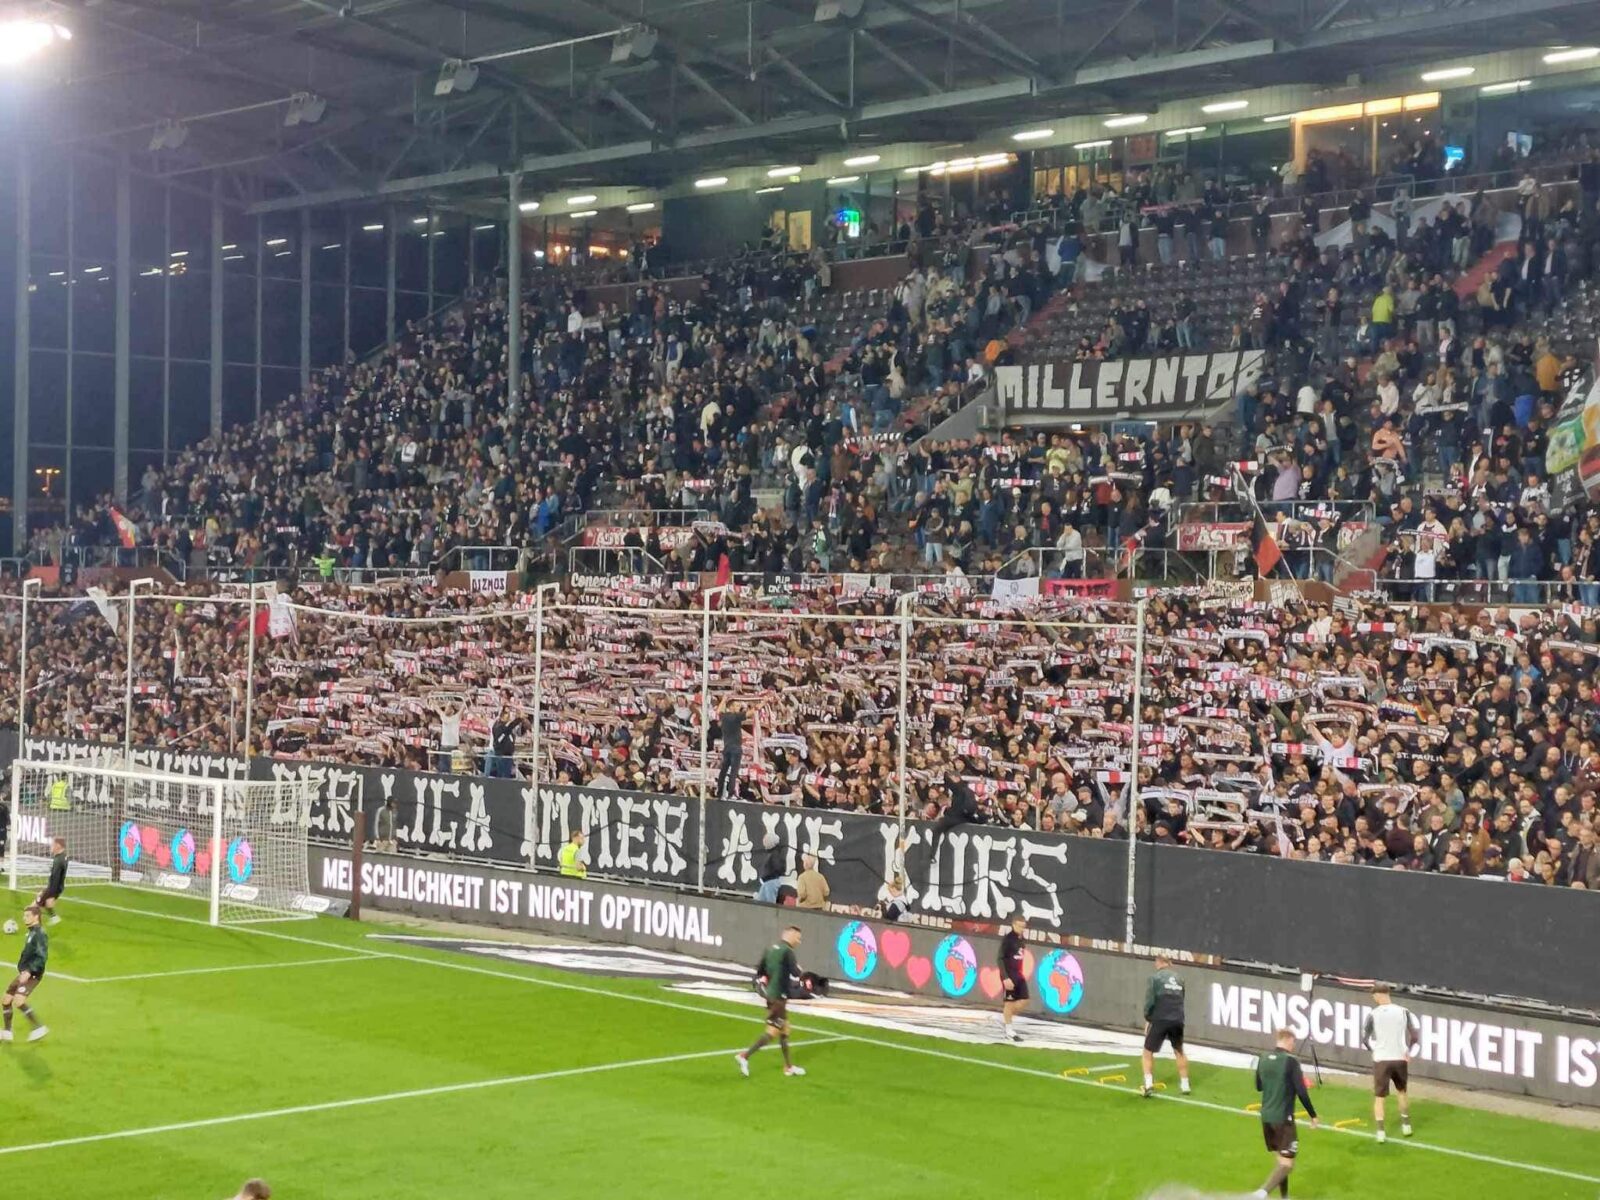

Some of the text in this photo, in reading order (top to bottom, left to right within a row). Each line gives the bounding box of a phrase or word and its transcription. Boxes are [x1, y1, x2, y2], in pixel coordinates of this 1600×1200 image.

[995, 351, 1264, 409] MILLERNTOR
[272, 763, 357, 832] DER
[520, 788, 688, 876] IMMER
[877, 823, 1067, 927] KURS
[490, 879, 522, 915] IST
[528, 883, 594, 925] NICHT
[600, 894, 723, 946] OPTIONAL.
[1556, 1035, 1600, 1088] IS
